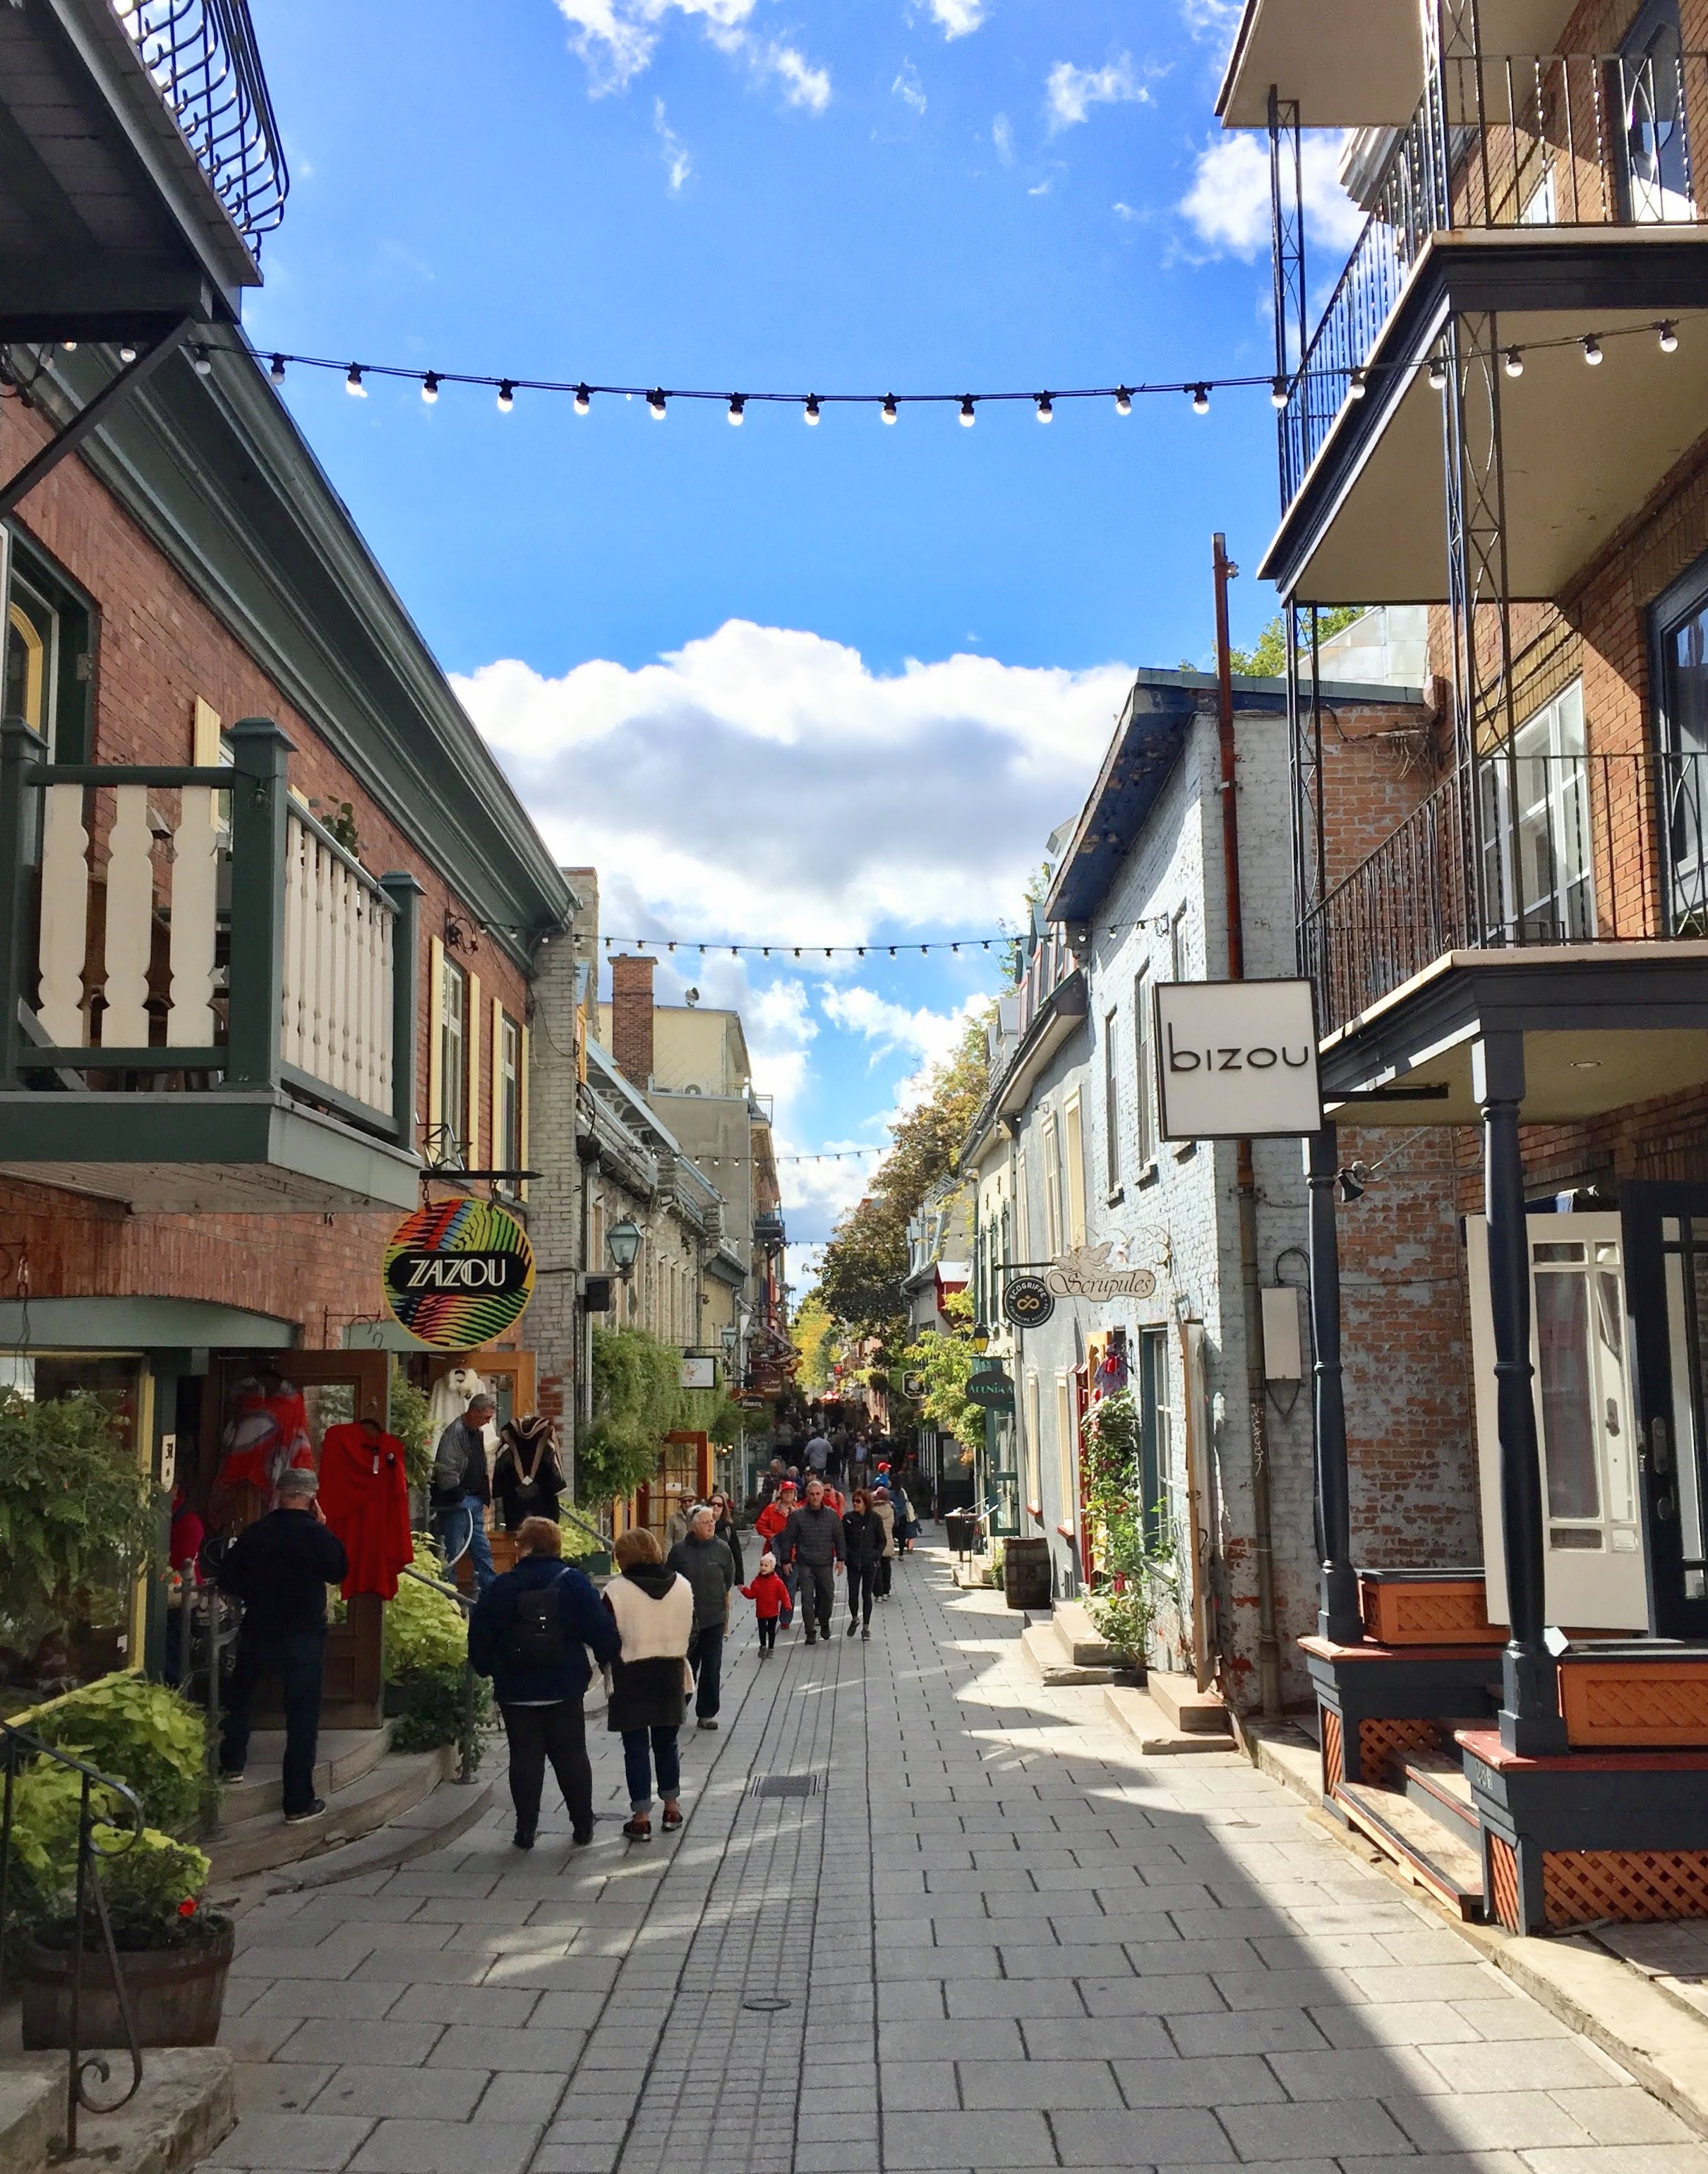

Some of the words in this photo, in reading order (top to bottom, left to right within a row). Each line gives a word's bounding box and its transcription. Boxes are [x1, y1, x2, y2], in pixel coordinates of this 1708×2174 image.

[1168, 1022, 1309, 1072] bizou
[407, 1259, 506, 1287] ZAZOU
[1050, 1273, 1151, 1300] Scrupules
[1009, 1282, 1047, 1300] ECOGRIFFE
